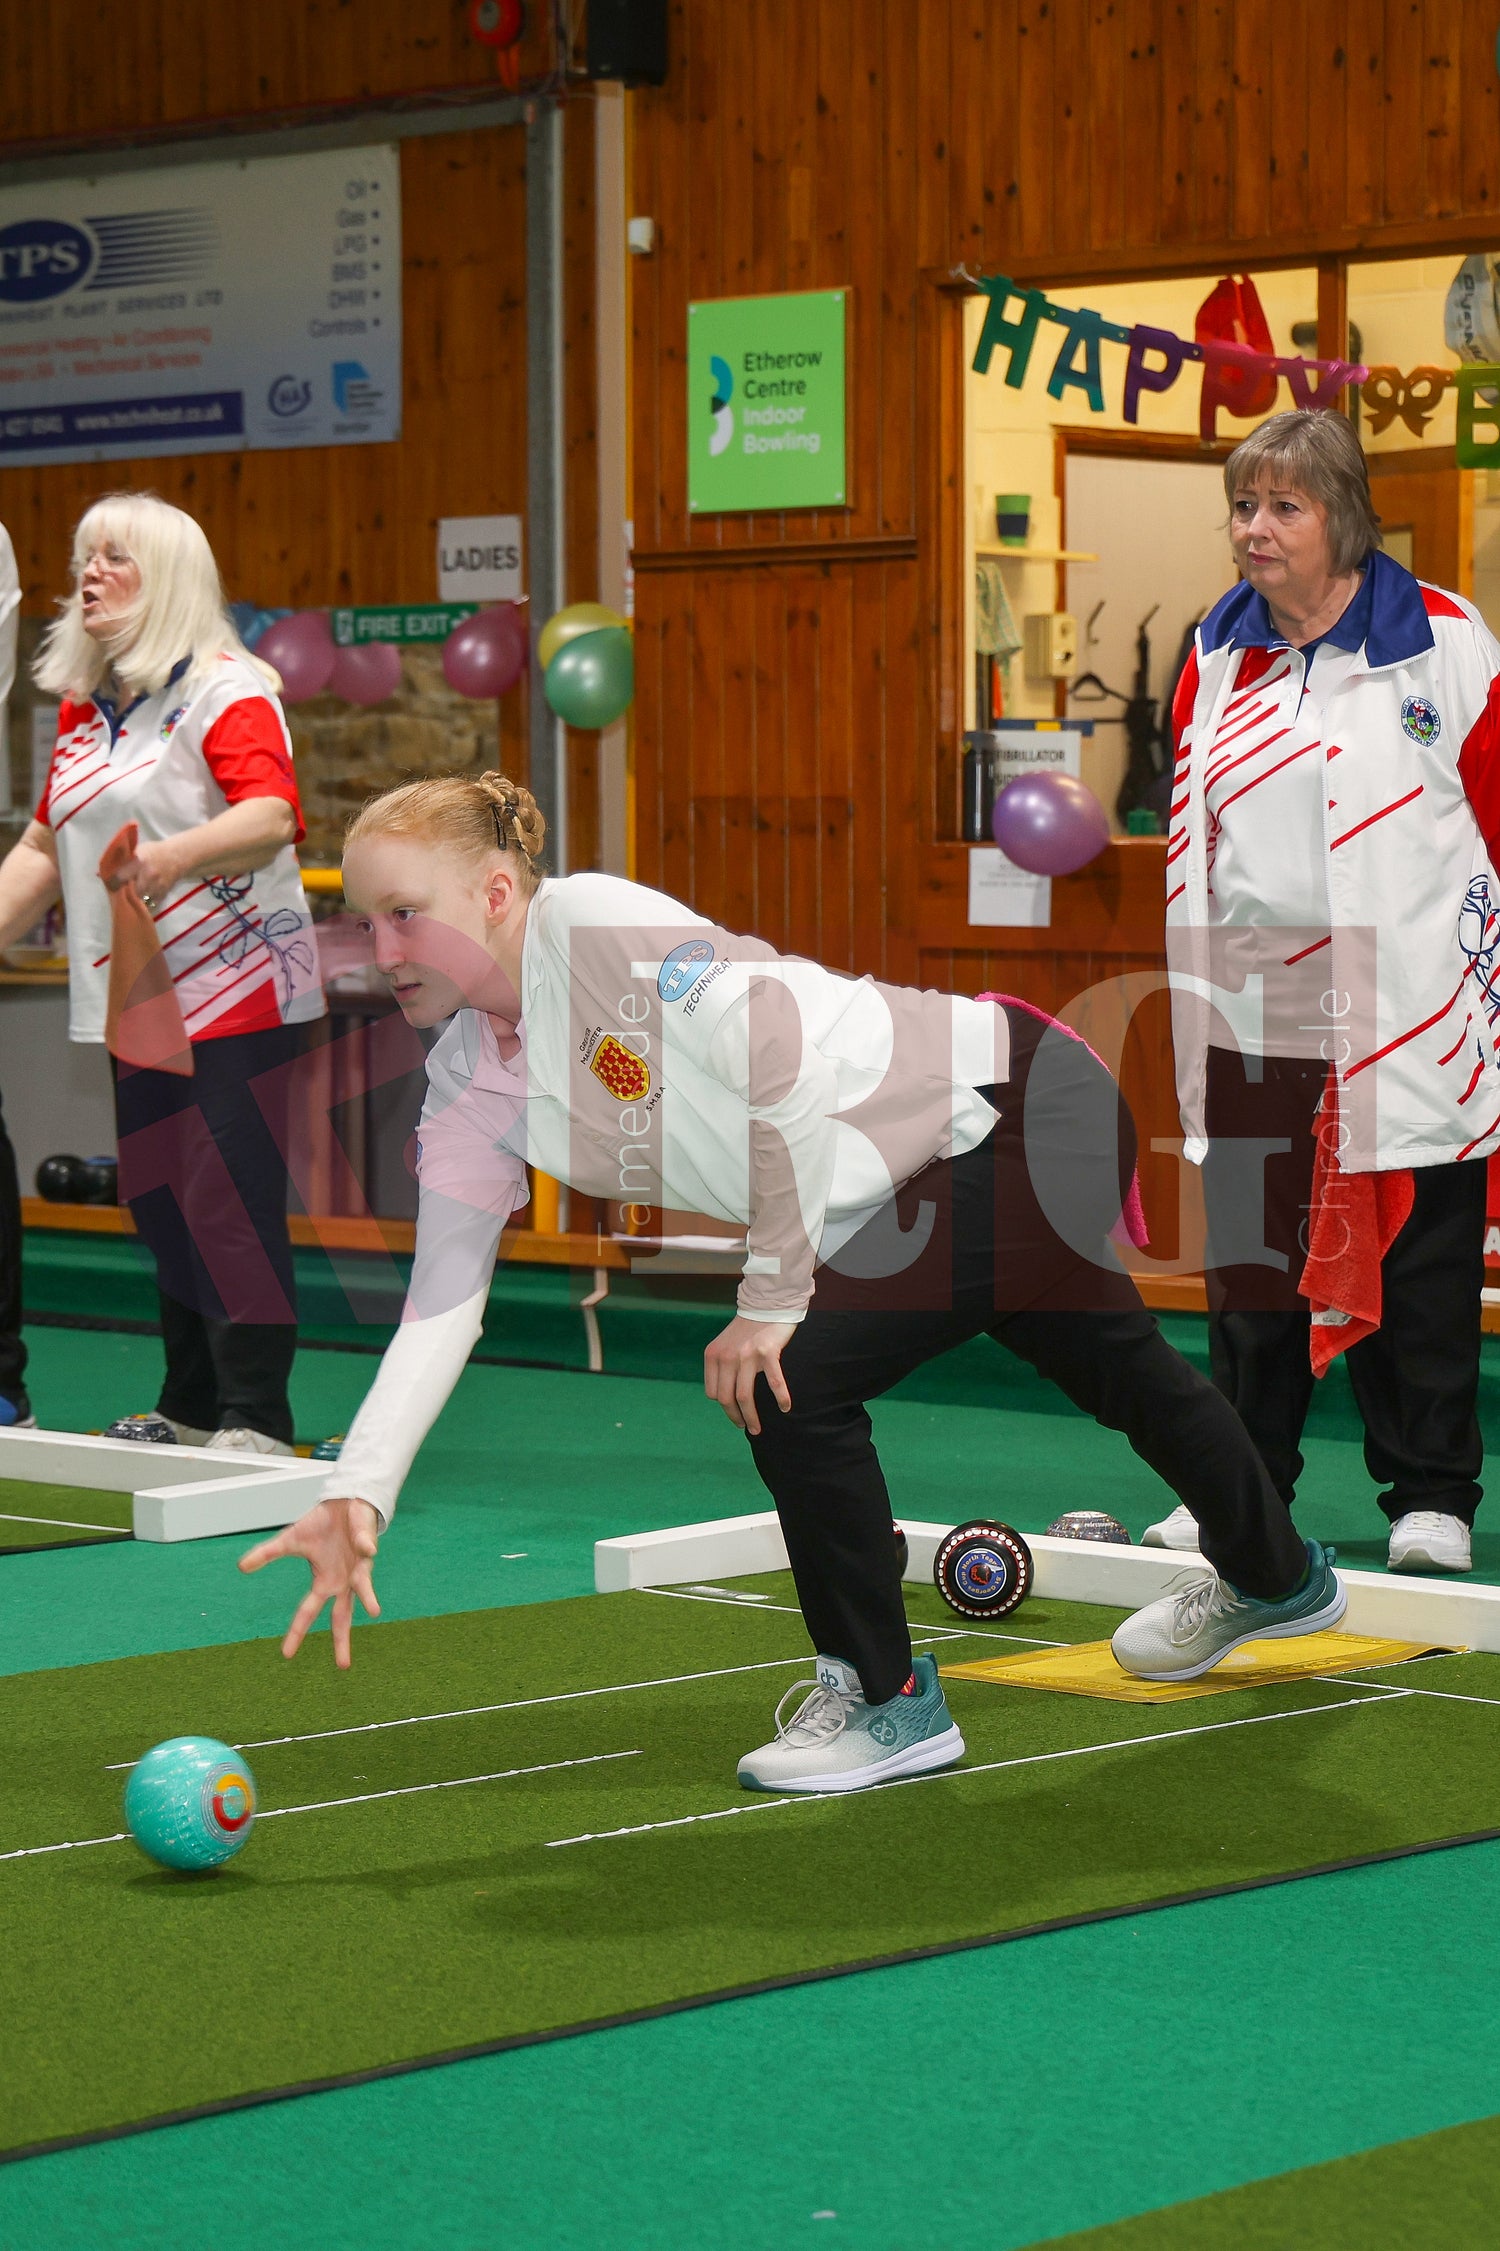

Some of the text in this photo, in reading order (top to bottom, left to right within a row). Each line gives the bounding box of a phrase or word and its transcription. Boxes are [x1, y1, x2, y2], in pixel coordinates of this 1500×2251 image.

[743, 351, 823, 372] Etherow
[743, 378, 808, 400] Centre
[742, 405, 807, 427] Indoor
[742, 430, 822, 455] Bowling
[441, 545, 519, 573] LADIES
[357, 611, 450, 639] FIRE EXIT
[993, 748, 1066, 763] FIBRILLATOR
[663, 943, 709, 993] TPS
[682, 956, 734, 1018] TECHNIHEAT
[961, 1554, 979, 1570] North
